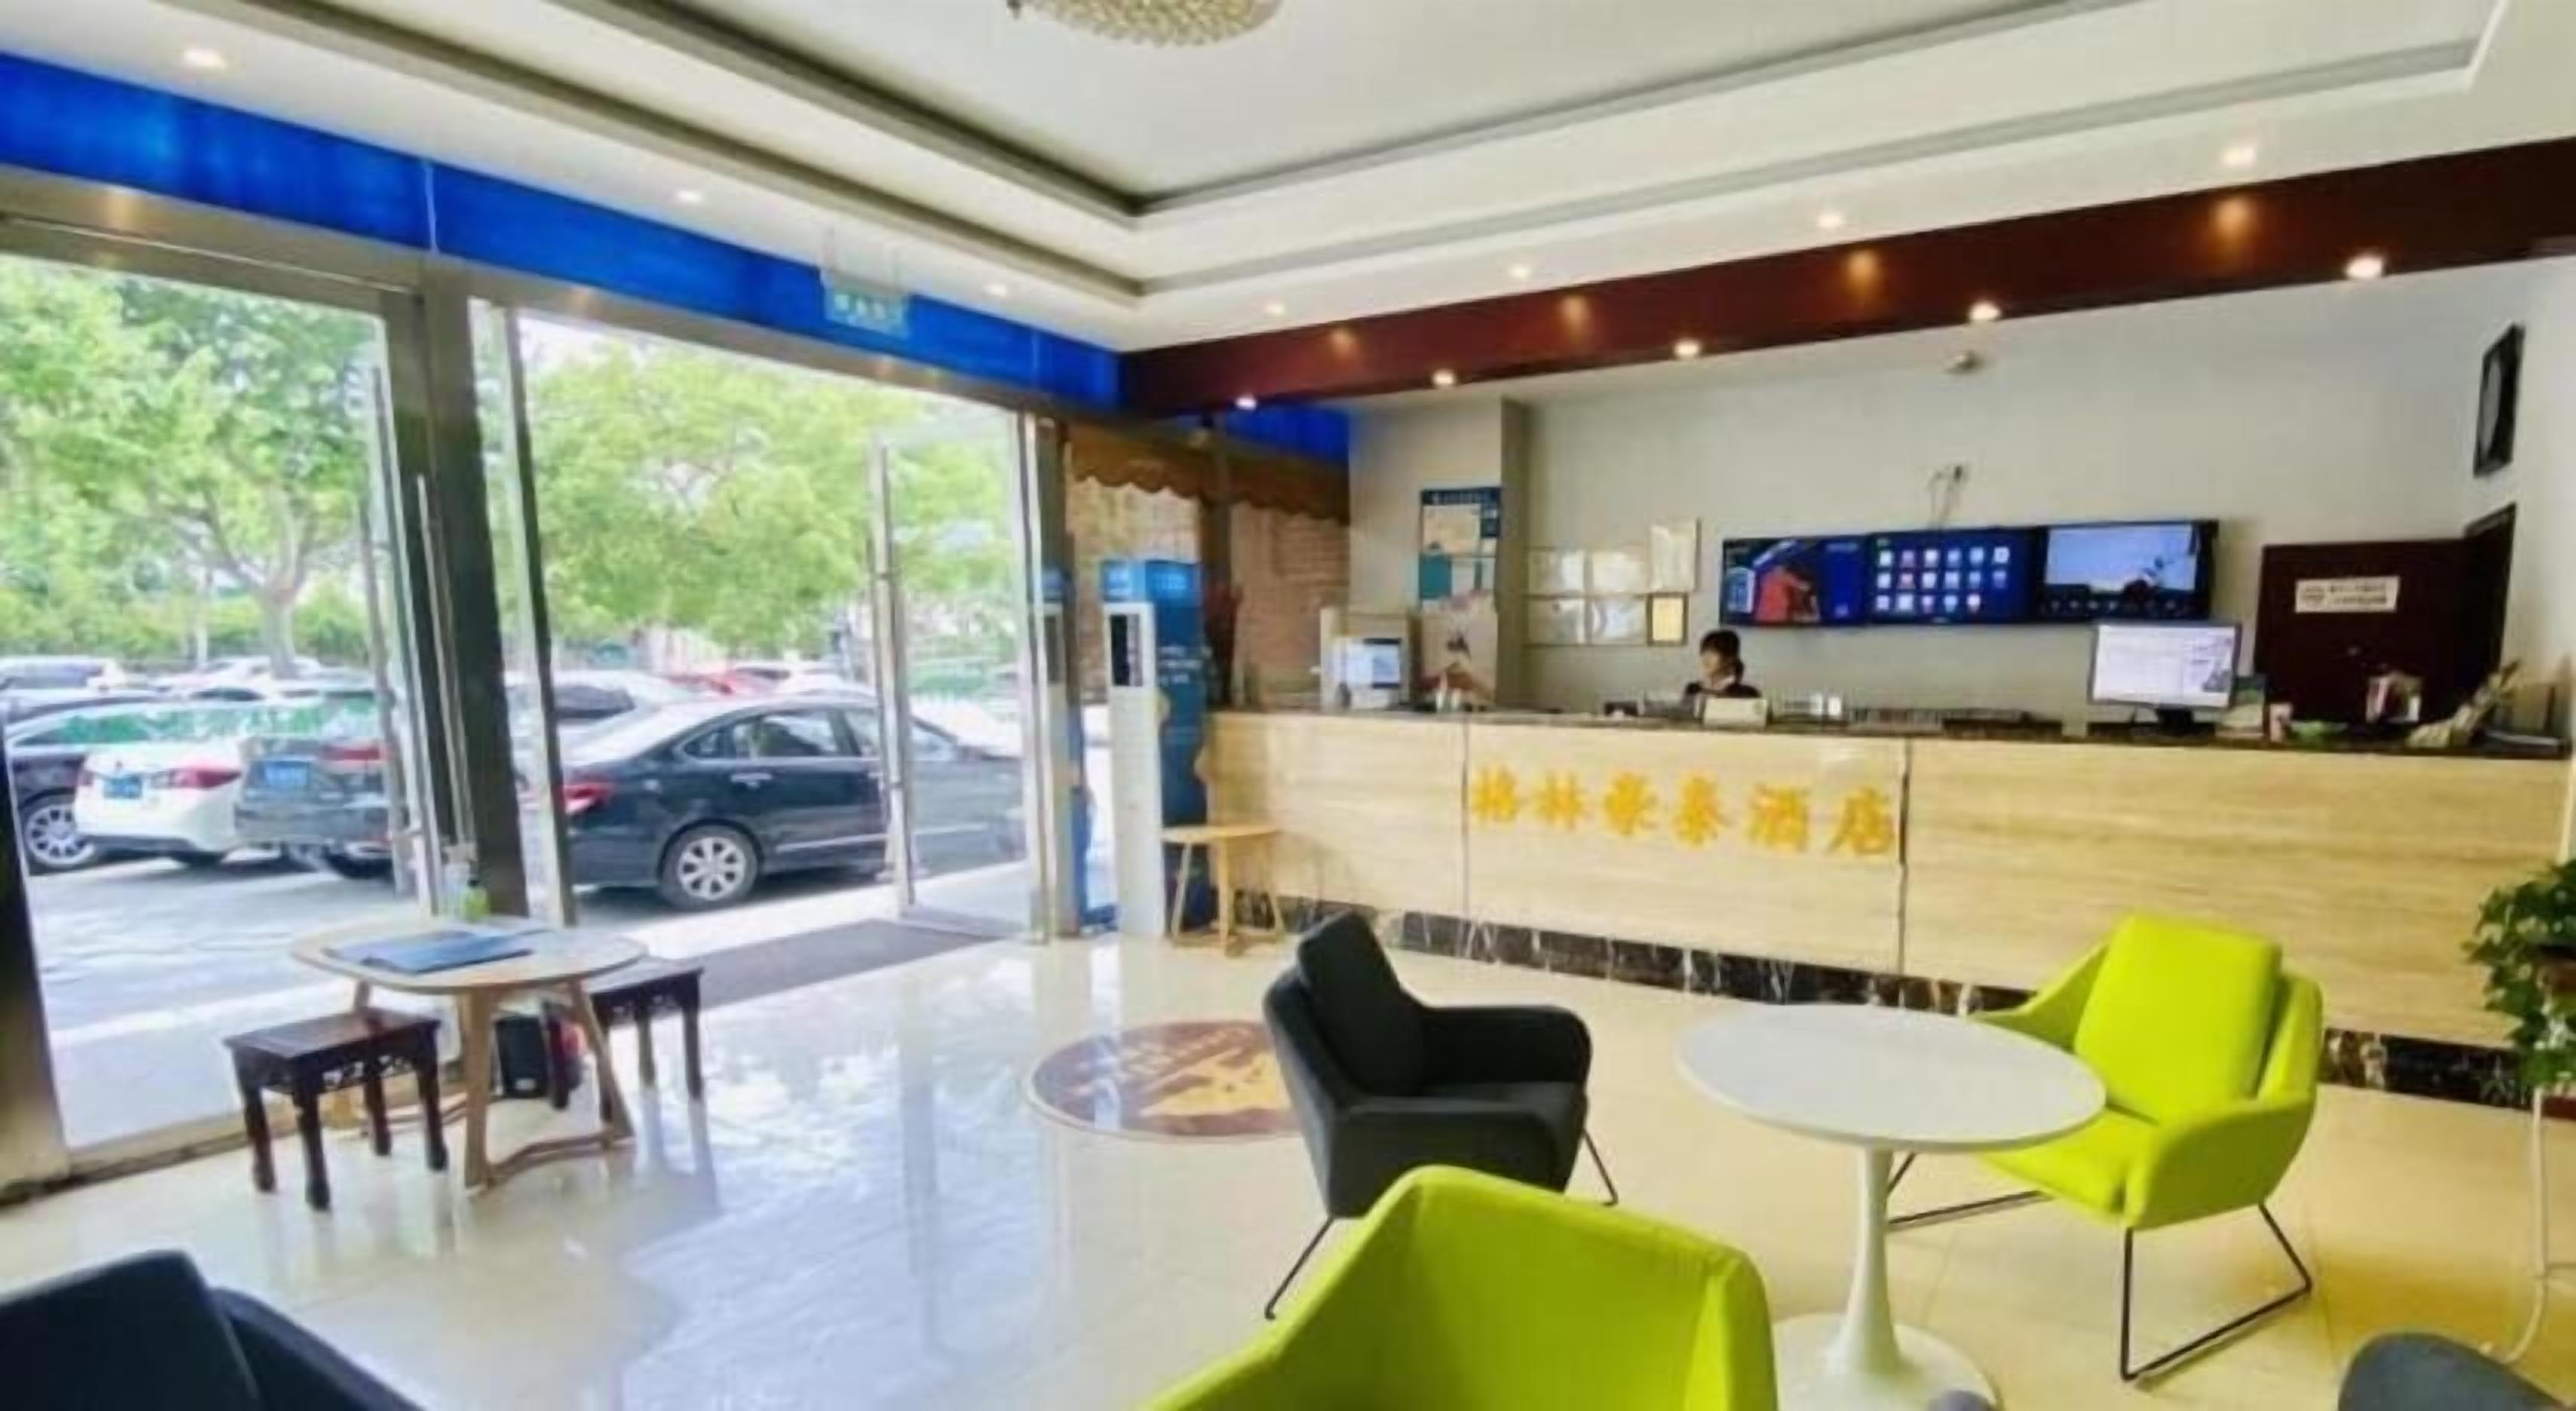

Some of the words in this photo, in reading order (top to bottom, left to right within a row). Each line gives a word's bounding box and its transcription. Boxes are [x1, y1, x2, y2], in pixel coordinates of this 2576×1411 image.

[1471, 764, 1897, 854] 格林豪泰酒店
